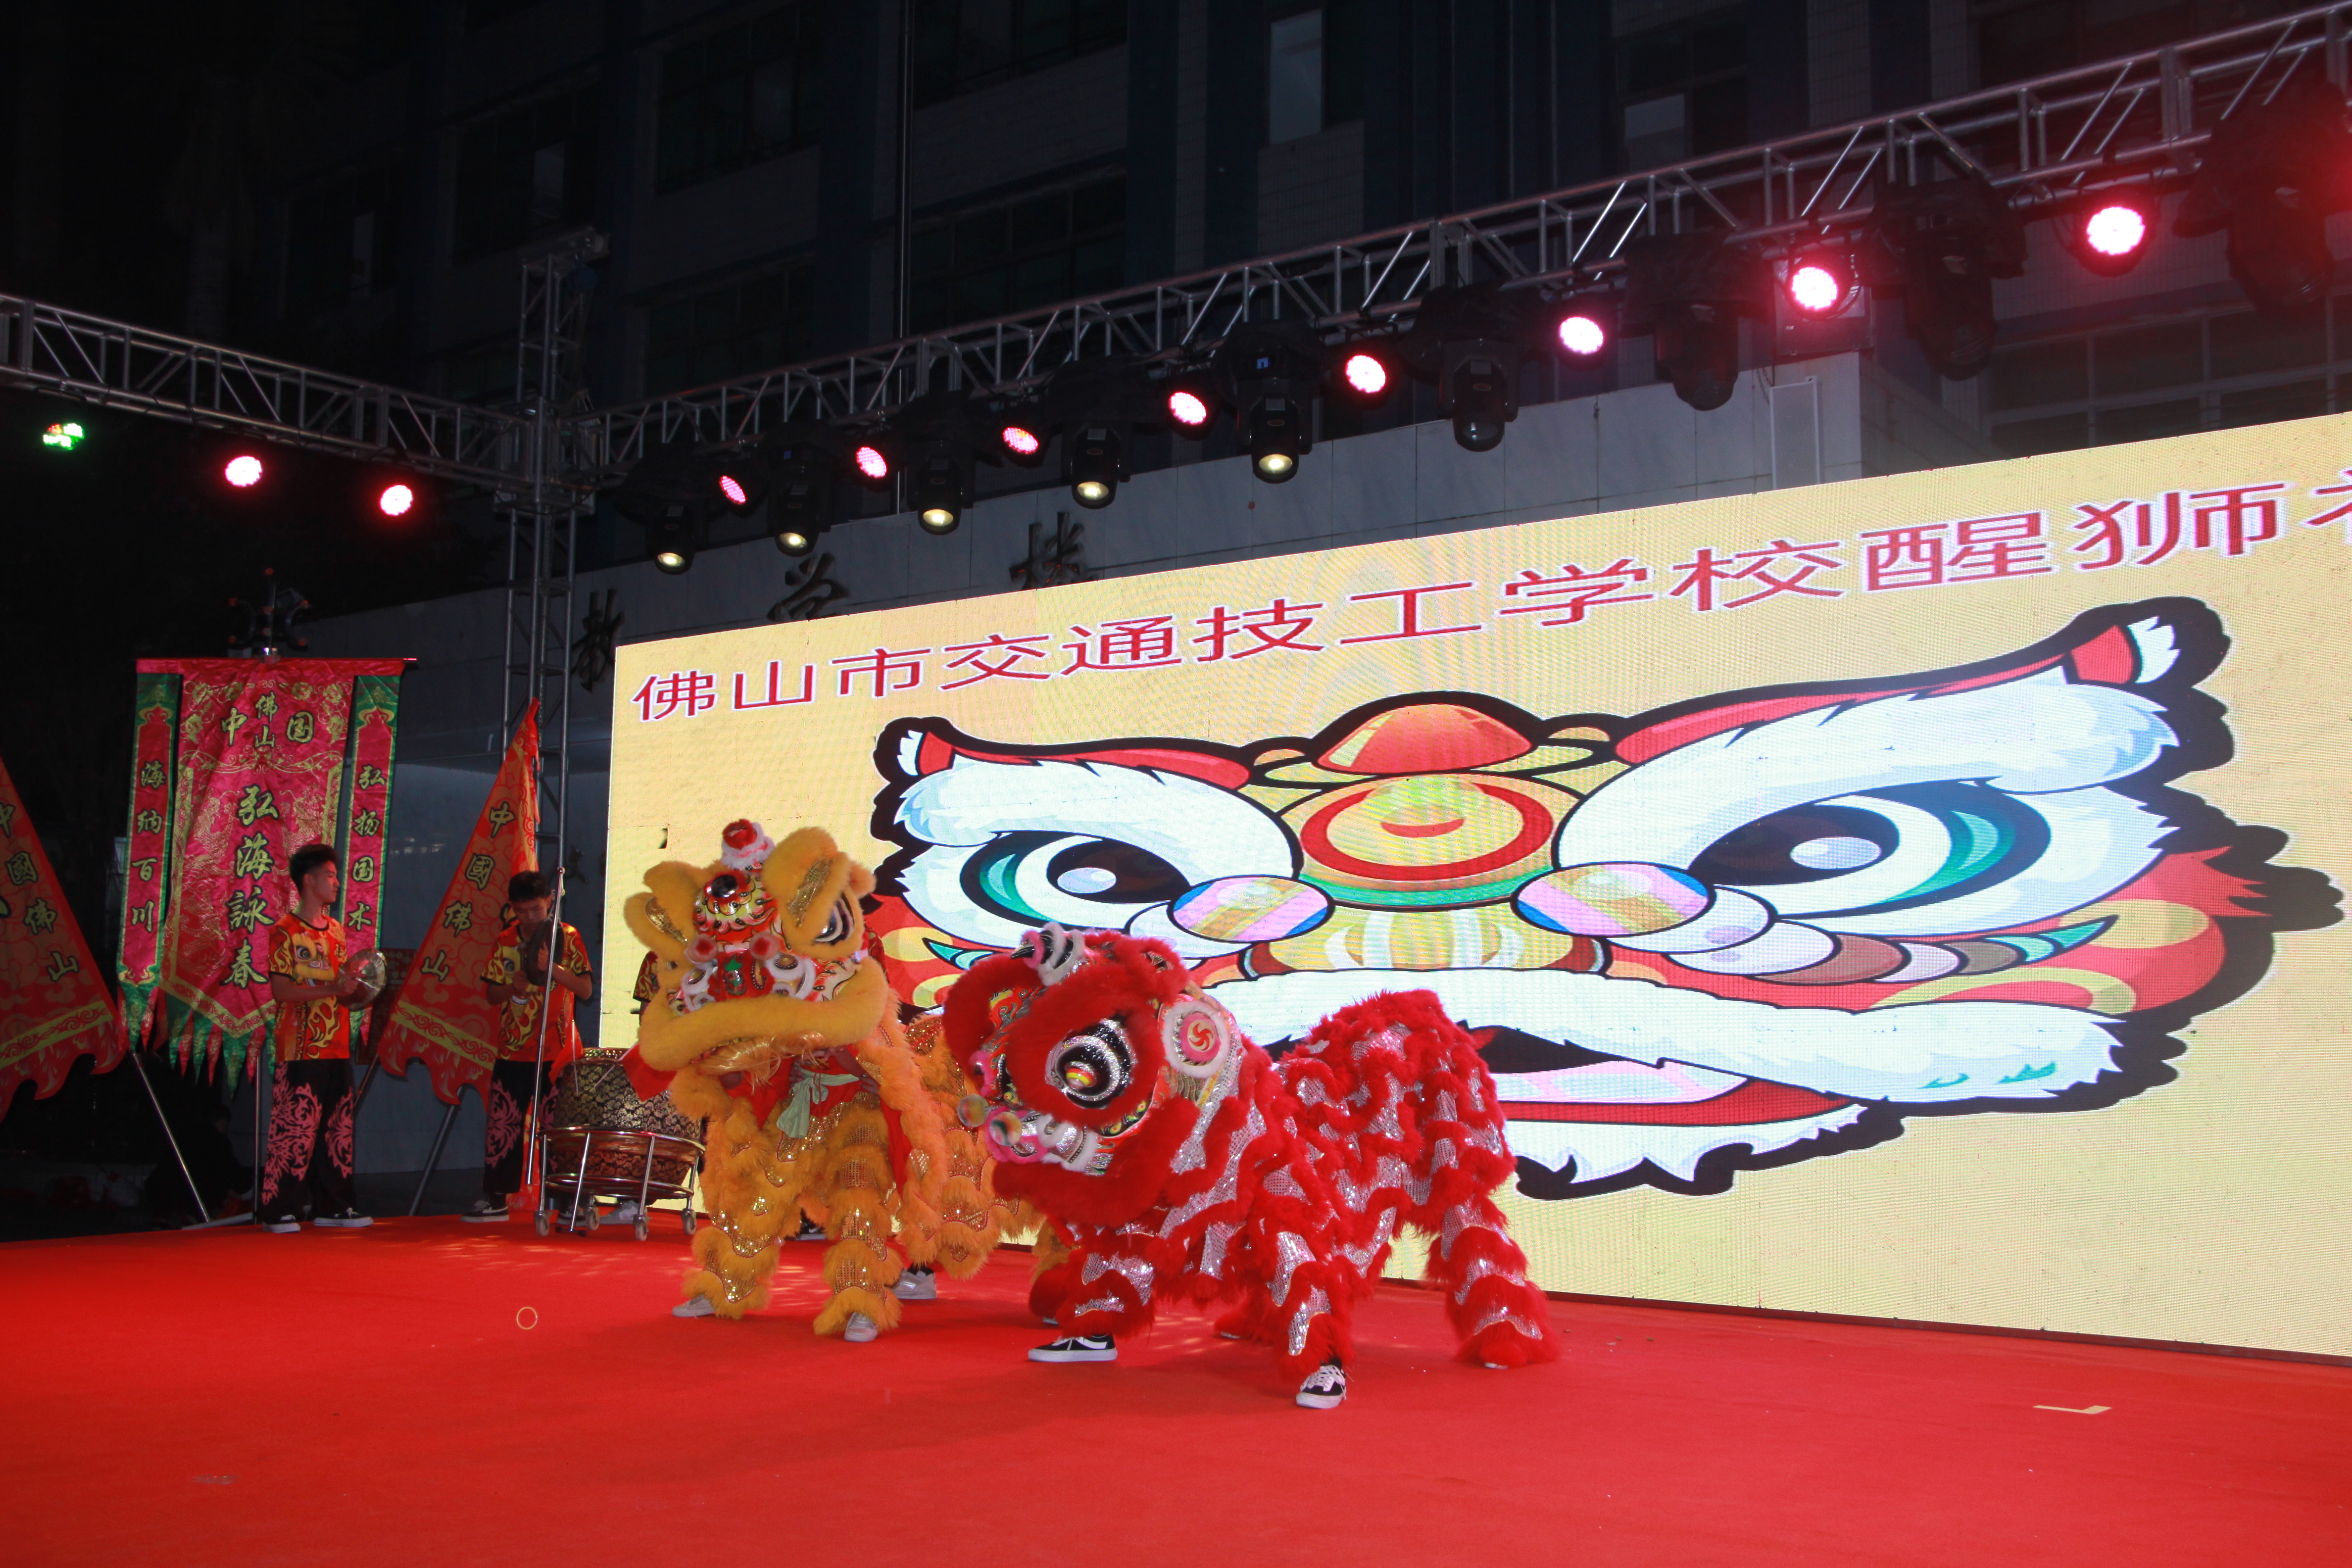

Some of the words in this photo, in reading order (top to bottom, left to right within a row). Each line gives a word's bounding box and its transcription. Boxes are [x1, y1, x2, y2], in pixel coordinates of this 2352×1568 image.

[131, 760, 167, 932] 海纳百川
[348, 765, 386, 931] 弘扬国术
[421, 800, 516, 982] 中國佛山
